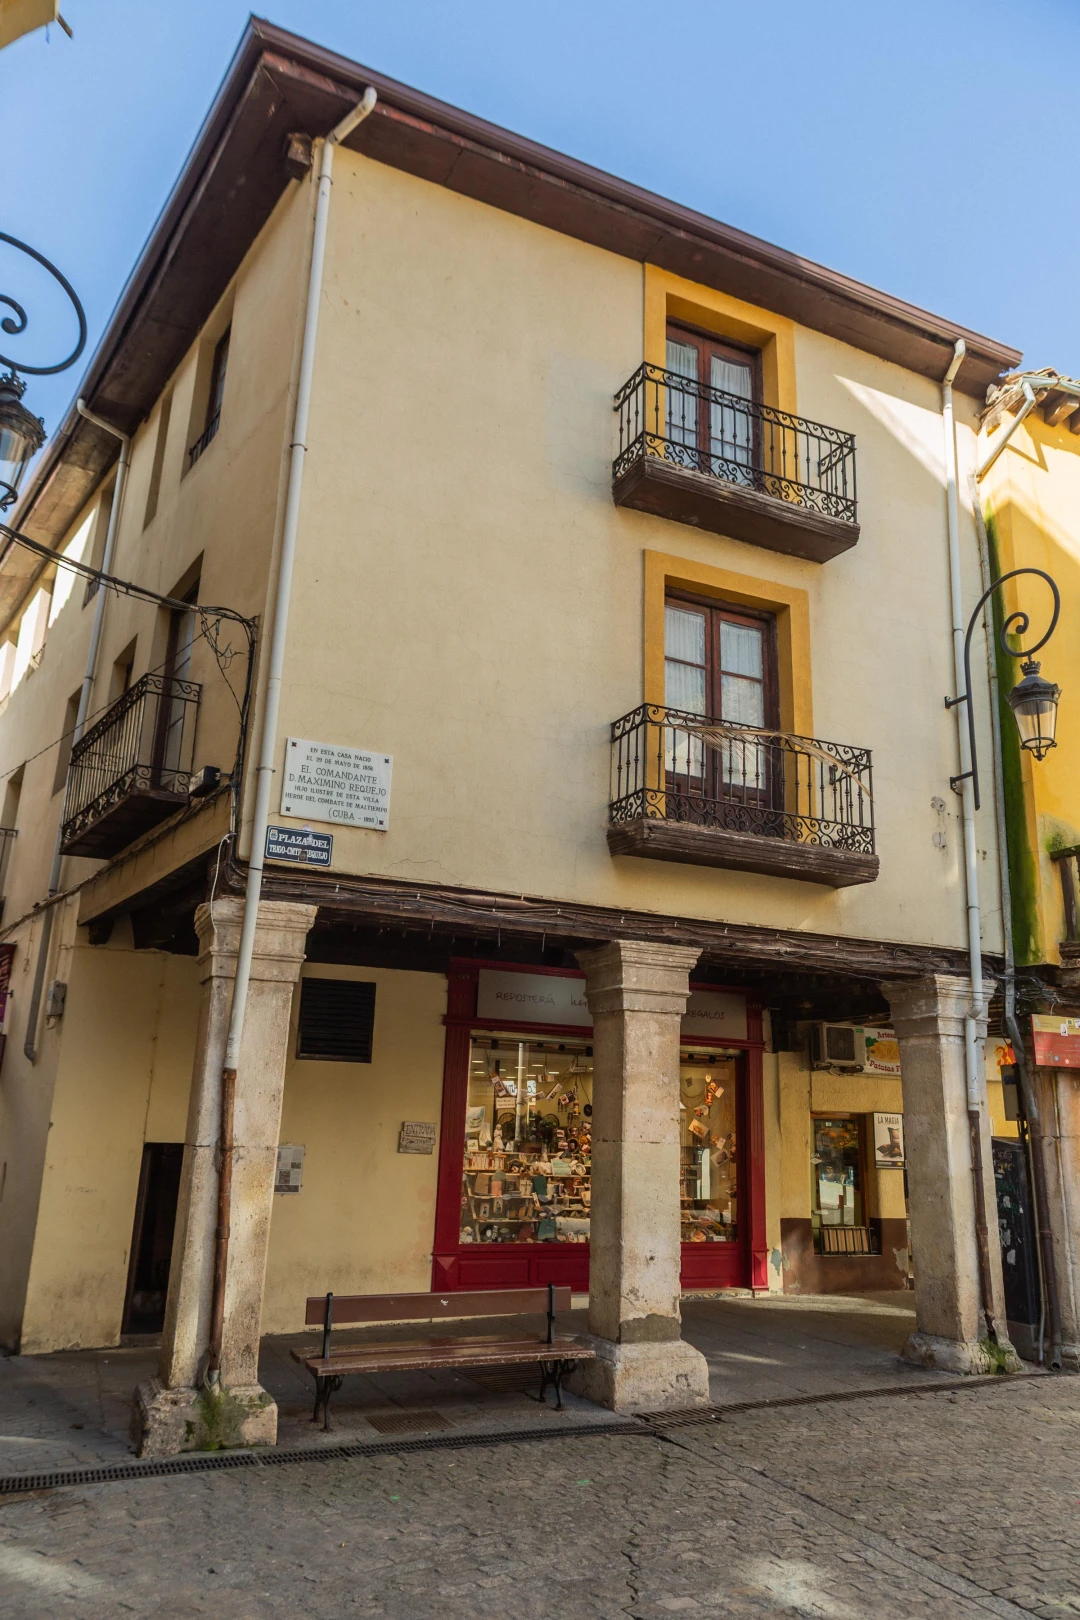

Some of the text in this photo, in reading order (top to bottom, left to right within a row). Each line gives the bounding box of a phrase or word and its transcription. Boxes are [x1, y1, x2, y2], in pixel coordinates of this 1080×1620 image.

[320, 749, 335, 757] ESTA
[337, 752, 352, 760] CASA
[354, 754, 372, 763] NACIO
[334, 760, 351, 768] MAYO
[301, 764, 378, 785] EL COMANDANTE
[297, 775, 346, 790] MAXIMINO
[348, 783, 387, 797] REQUEJO
[285, 792, 304, 801] HEROE
[317, 798, 345, 807] COMBATE
[346, 801, 354, 809] DE
[354, 804, 388, 813] MALTIEMPO
[310, 787, 334, 797] ILUSTRE
[345, 793, 360, 801] ESTA
[362, 796, 380, 804] VILLA
[328, 807, 356, 820] (CUBA
[278, 833, 330, 849] PLAZA DEL
[685, 1009, 725, 1020] REGALOS
[870, 1060, 895, 1073] Patatas
[877, 1115, 900, 1125] LA MAGIA
